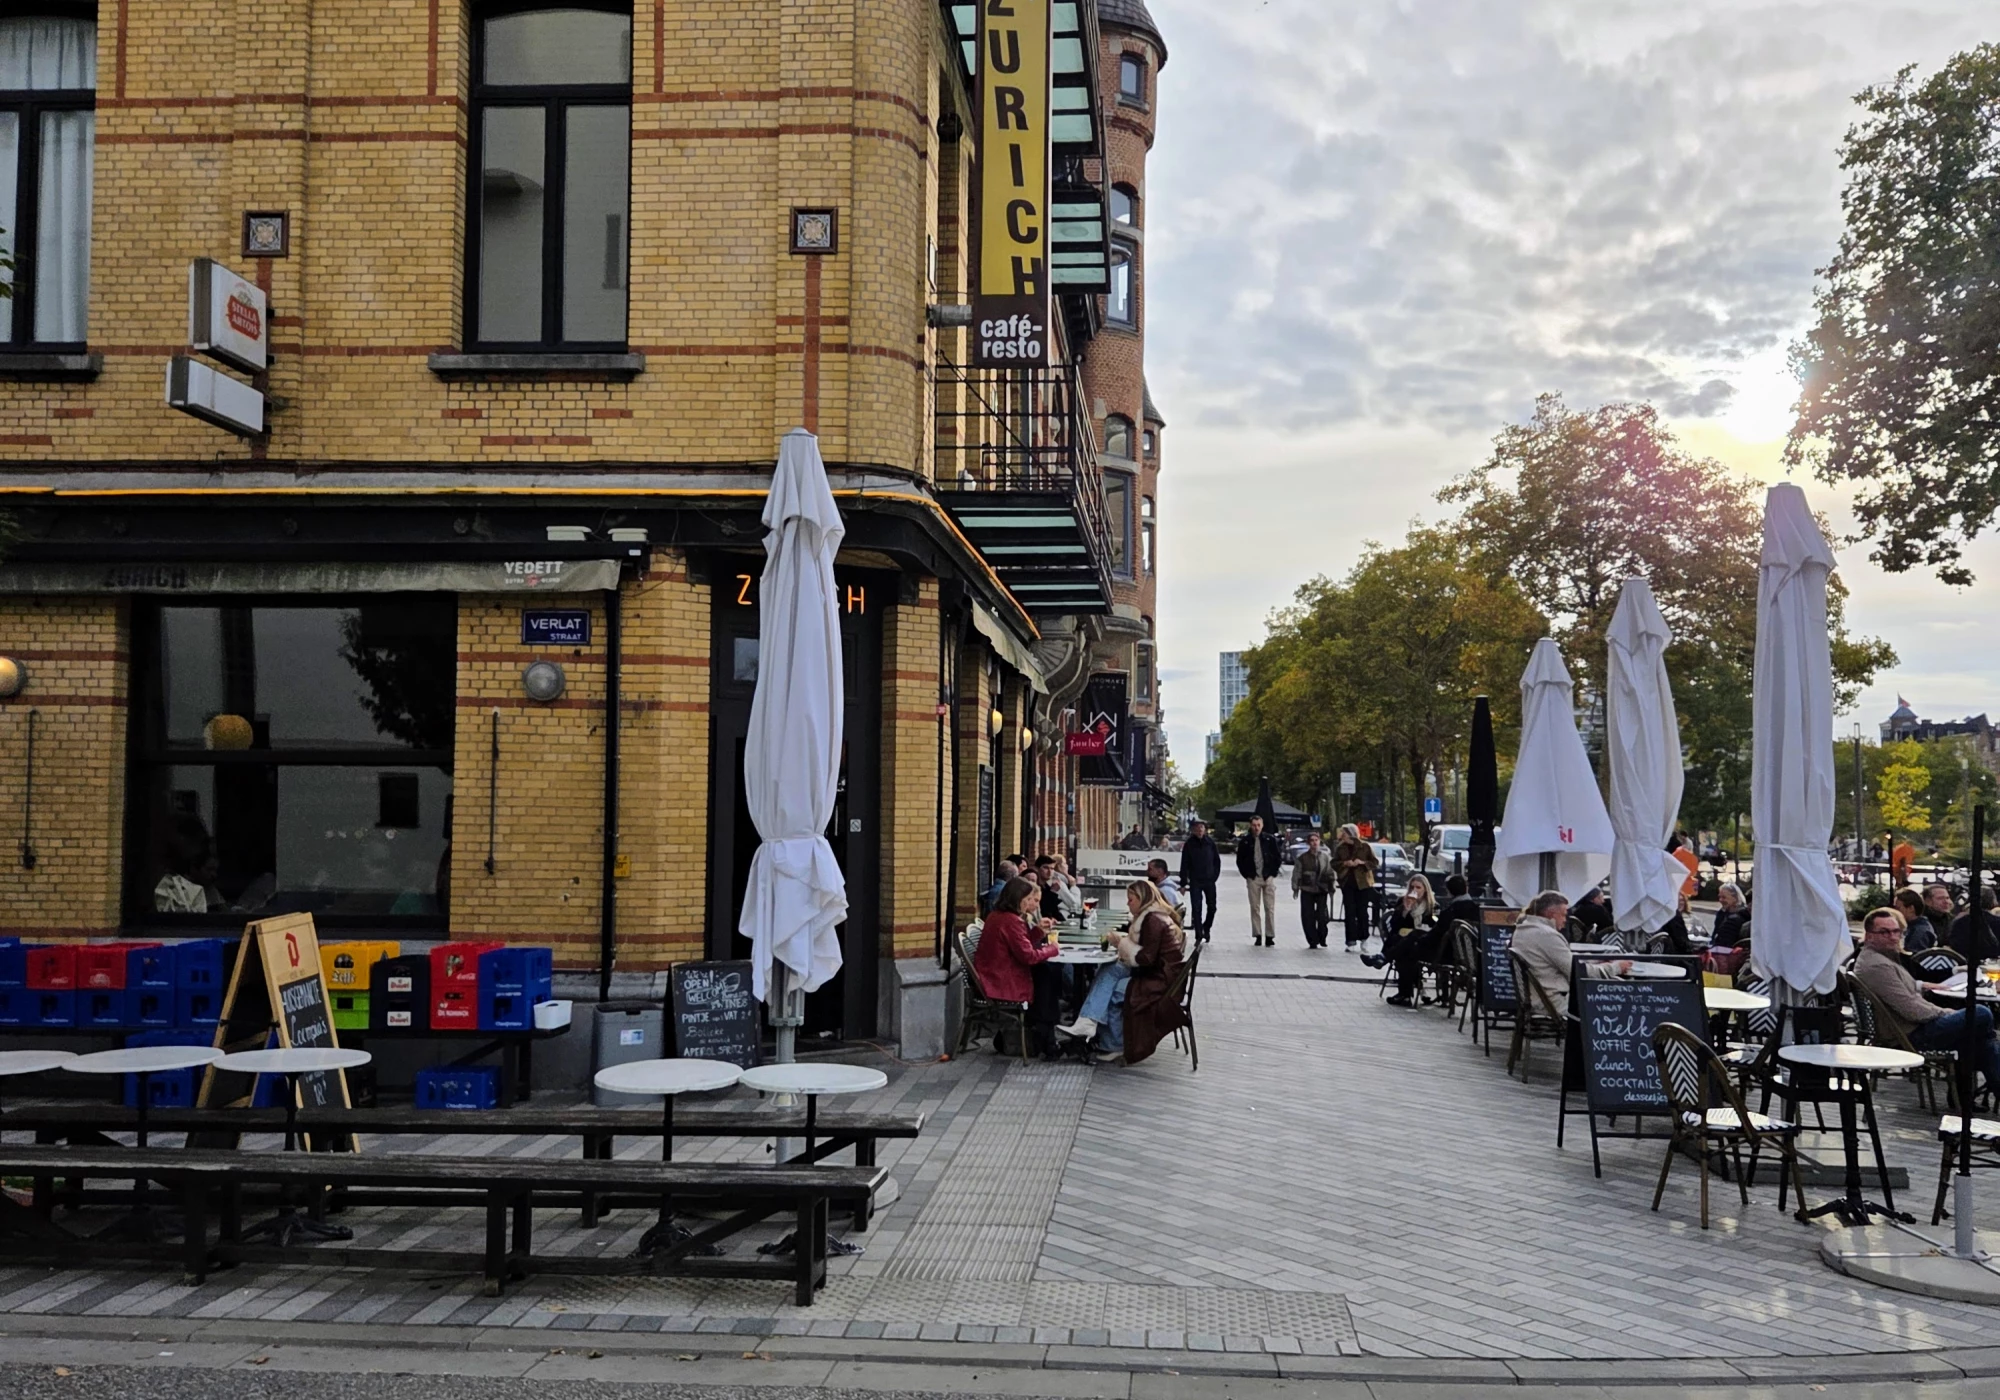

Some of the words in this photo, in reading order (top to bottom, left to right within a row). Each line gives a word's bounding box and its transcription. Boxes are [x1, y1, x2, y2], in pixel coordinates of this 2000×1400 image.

[231, 301, 258, 323] STELLA
[231, 313, 259, 335] ARTOIS
[980, 314, 1043, 338] café-
[982, 337, 1041, 359] resto
[504, 561, 564, 574] VEDETT
[530, 618, 582, 630] VERLAT
[1587, 994, 1626, 1002] MAANDAG
[1596, 1004, 1622, 1012] VANAF
[1592, 1039, 1632, 1052] KOFFIE
[1594, 1054, 1635, 1072] Lunch
[1600, 1077, 1663, 1089] COCKTAILS
